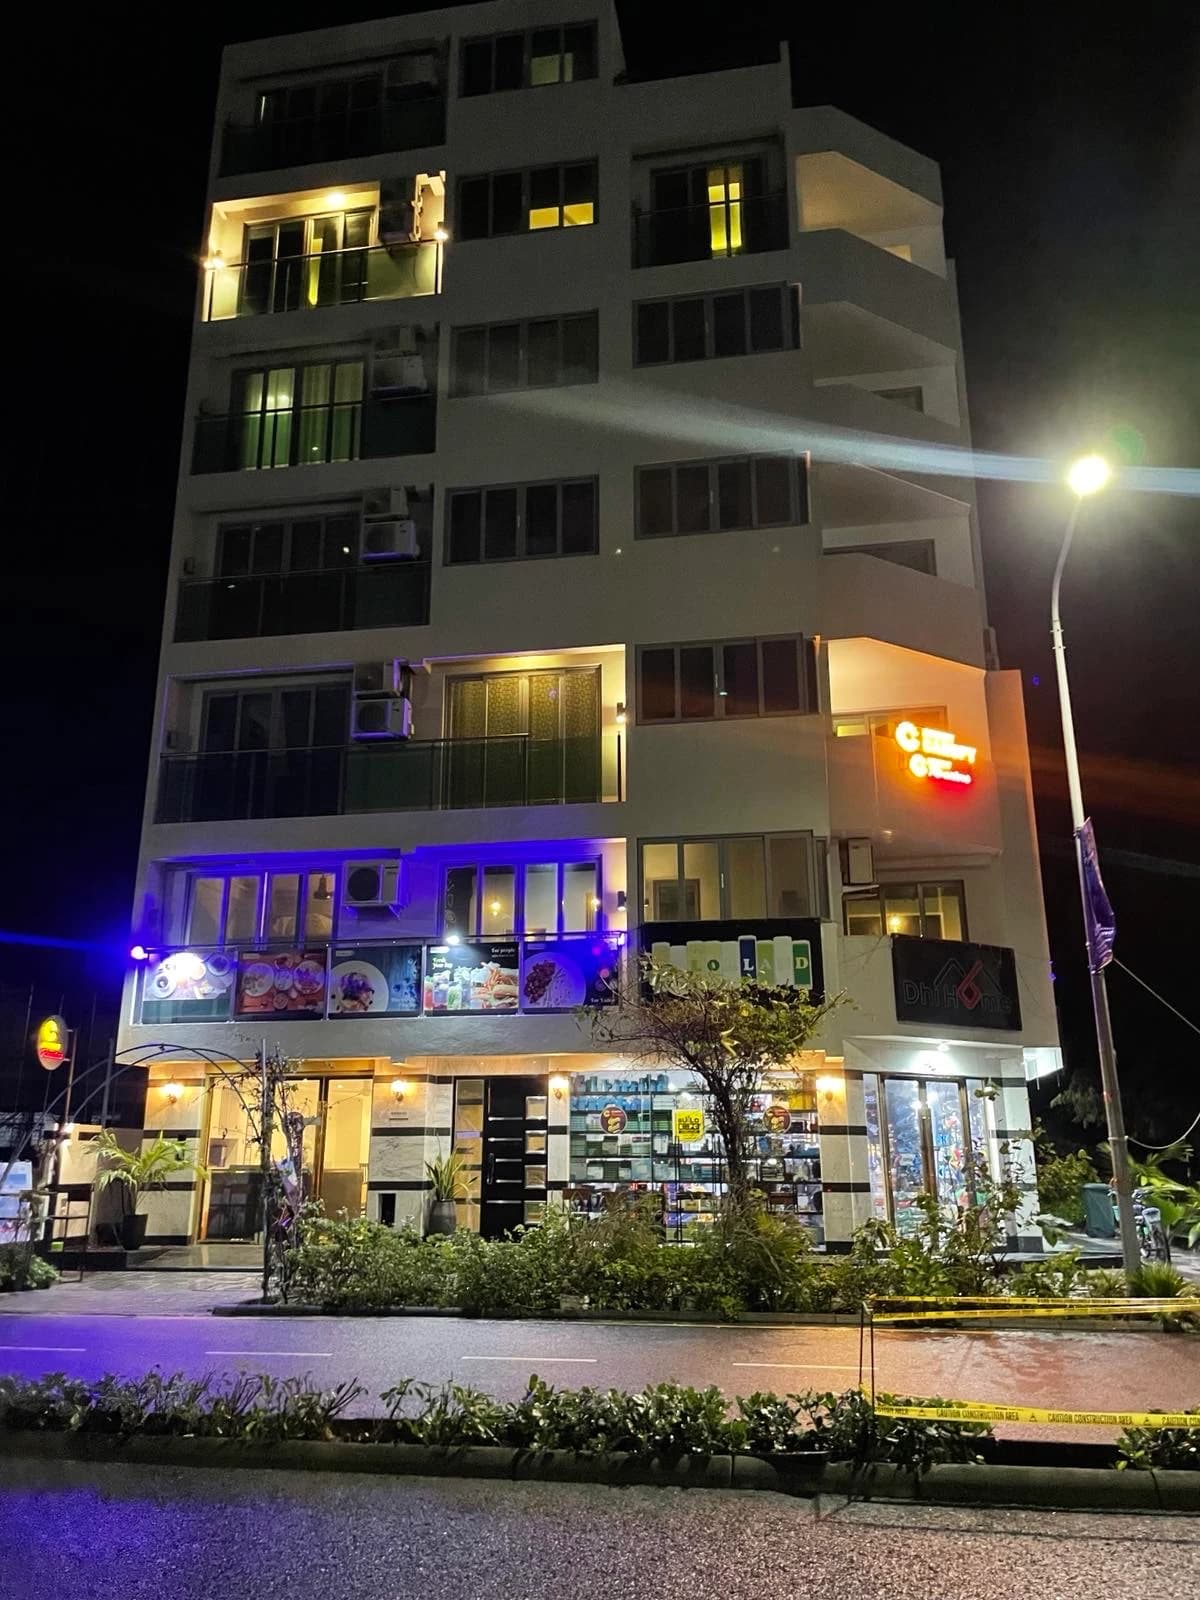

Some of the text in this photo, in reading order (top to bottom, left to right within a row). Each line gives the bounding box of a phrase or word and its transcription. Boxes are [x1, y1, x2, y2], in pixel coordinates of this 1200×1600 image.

[936, 1408, 1019, 1421] CAUTION CONSTRUCTION AREA
[1047, 1413, 1133, 1425] CAUTION CONSTRUCTION AREA
[1161, 1416, 1188, 1426] CAUTION
